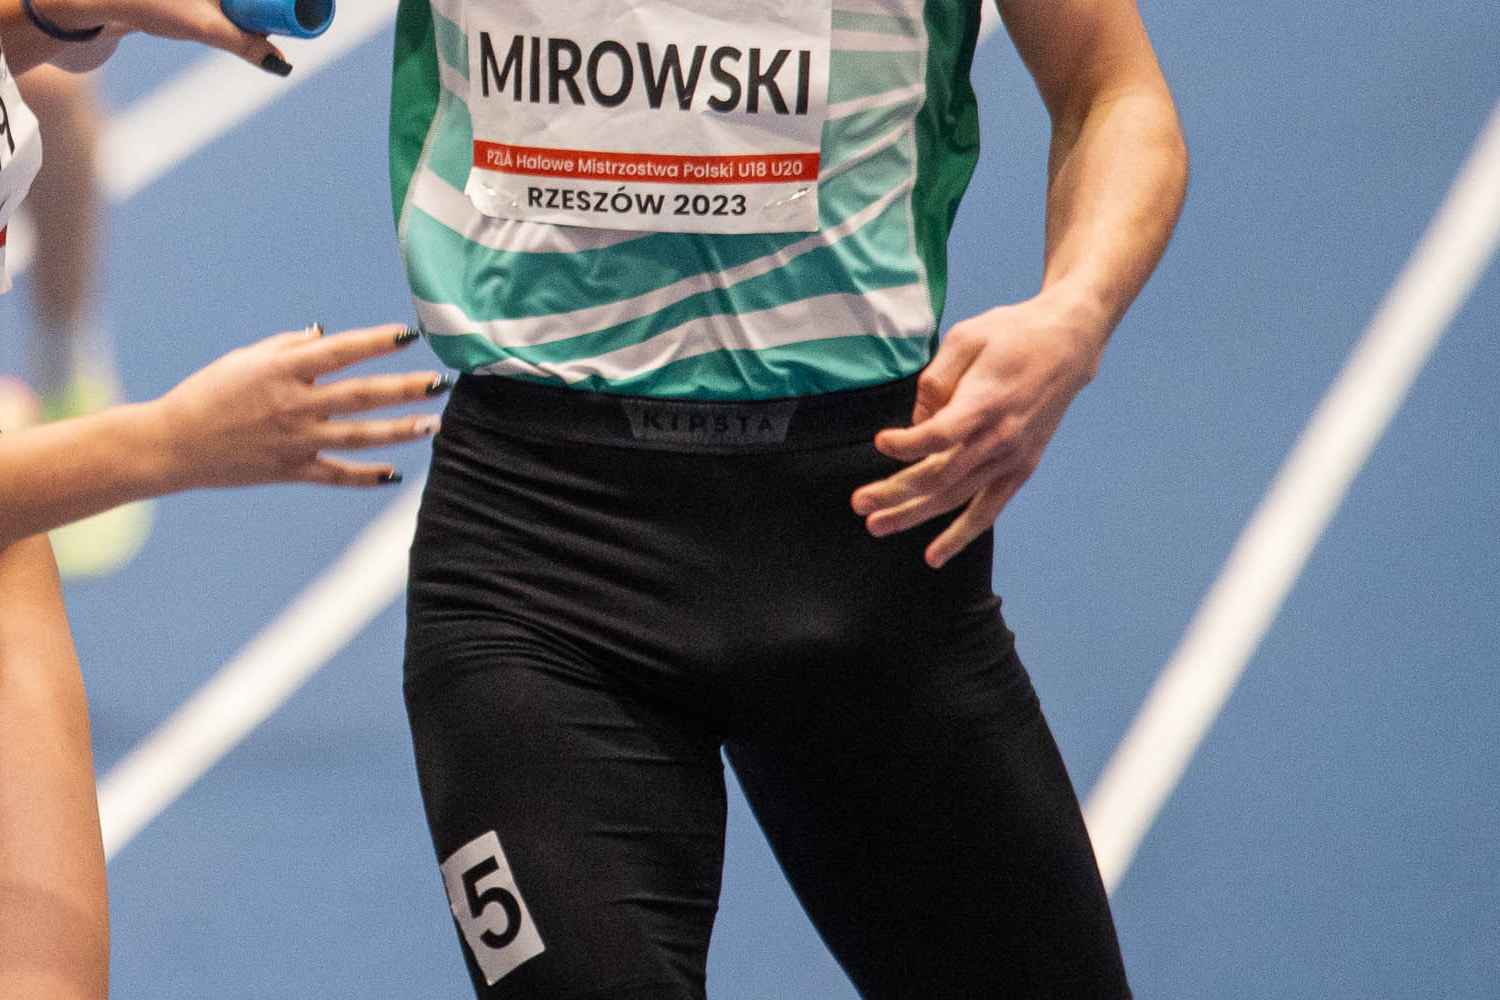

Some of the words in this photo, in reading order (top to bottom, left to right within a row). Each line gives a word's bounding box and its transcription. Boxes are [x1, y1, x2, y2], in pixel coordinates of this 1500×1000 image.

[478, 31, 812, 117] MIROWSKI
[486, 149, 513, 168] PZLA
[516, 154, 574, 173] Halowe
[577, 158, 678, 178] Mistrzostwa
[683, 161, 734, 178] Polski
[737, 161, 767, 178] U18
[771, 160, 803, 177] U20
[527, 185, 665, 216] RZESZÓW
[673, 193, 747, 217] 2023
[642, 410, 774, 434] KIPSTA
[463, 855, 522, 950] 5
